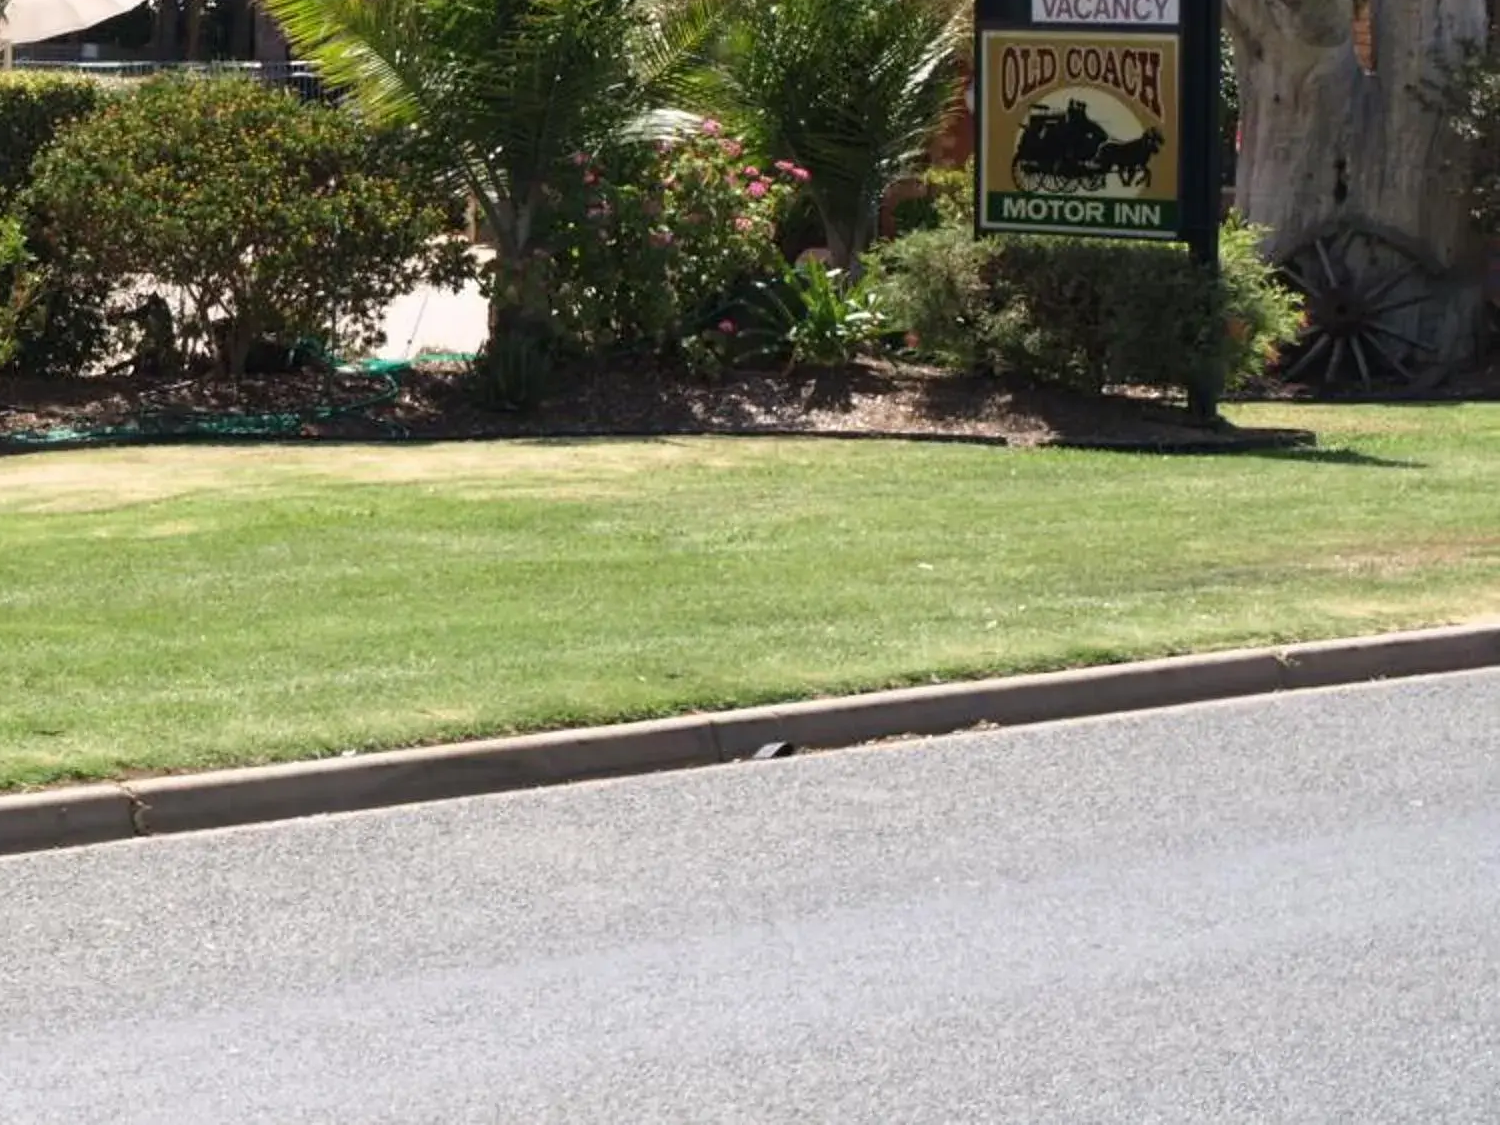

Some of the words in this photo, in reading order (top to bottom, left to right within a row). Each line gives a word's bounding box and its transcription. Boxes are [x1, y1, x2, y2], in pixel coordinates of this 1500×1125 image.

[1002, 46, 1057, 111] OLD
[1066, 47, 1164, 121] COACH
[1003, 196, 1106, 222] MOTOR
[1114, 203, 1162, 226] INN
